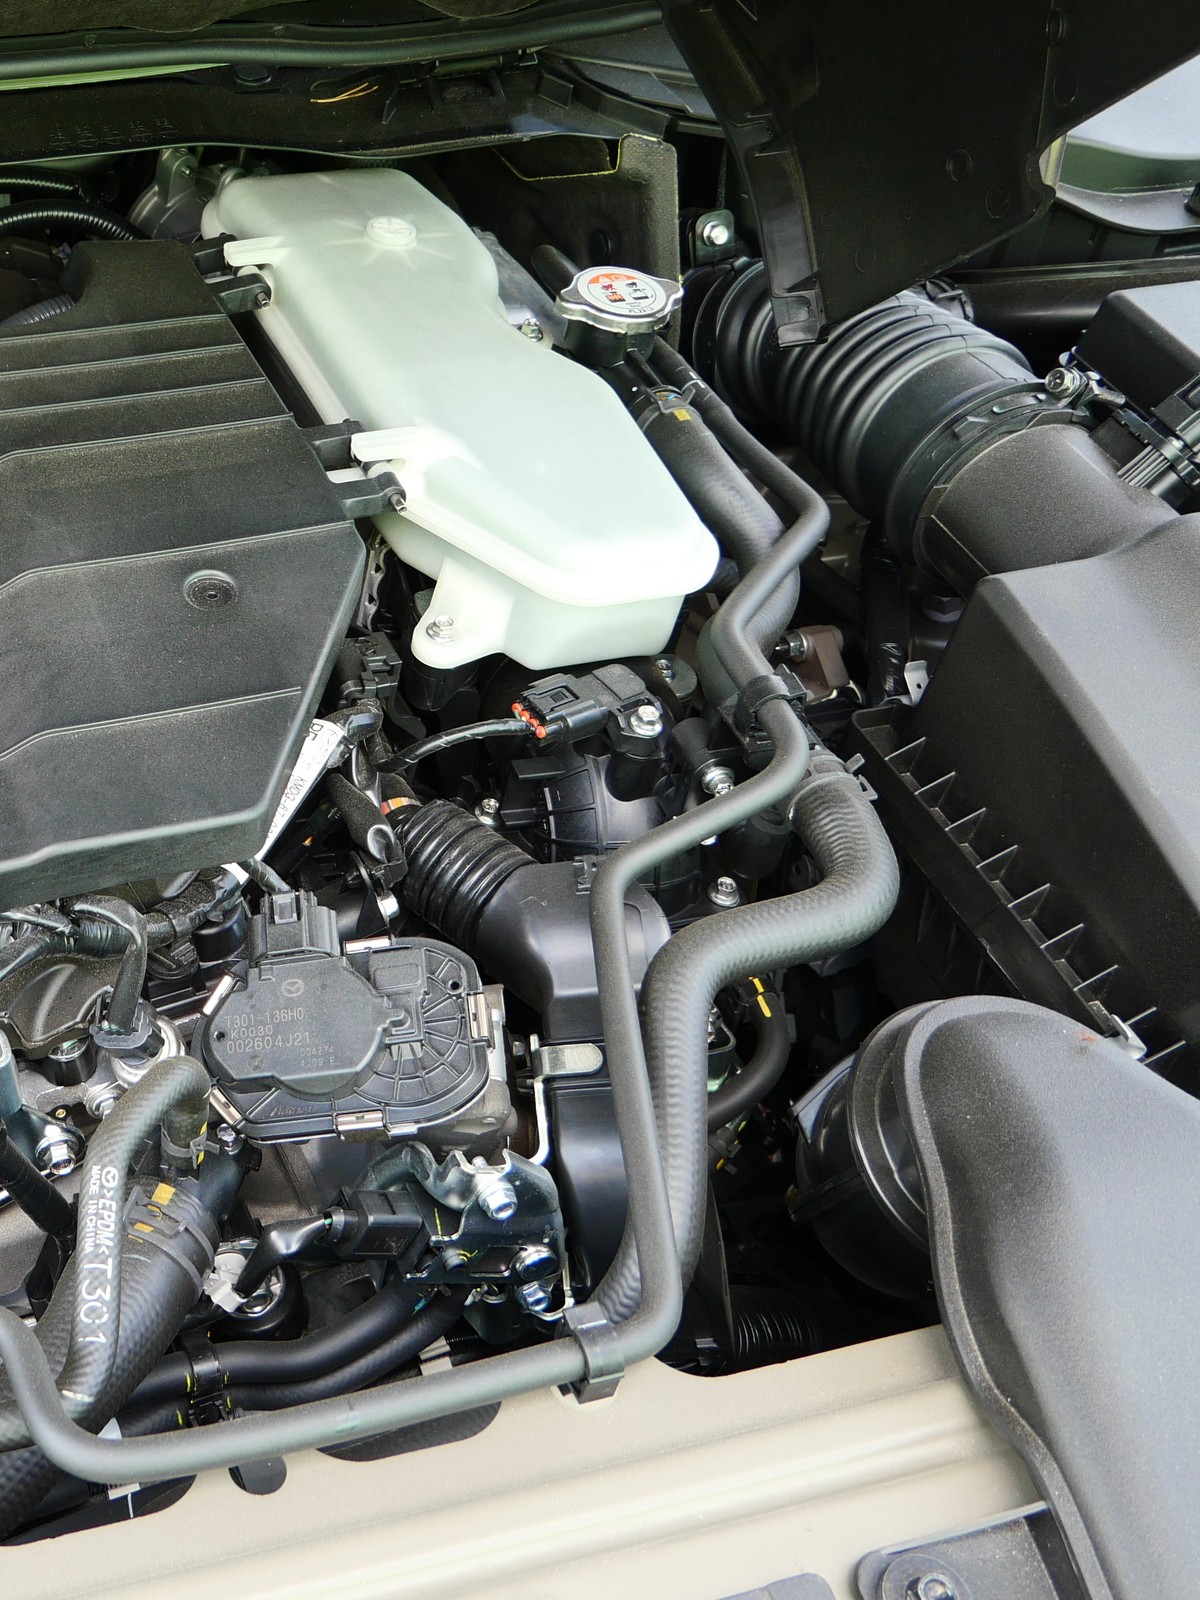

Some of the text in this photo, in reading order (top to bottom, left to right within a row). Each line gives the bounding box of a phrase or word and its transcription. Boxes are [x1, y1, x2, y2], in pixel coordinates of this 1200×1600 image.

[224, 1007, 304, 1028] T301-136H0
[227, 1031, 310, 1053] 002604J21
[231, 1025, 273, 1039] K0030
[84, 1165, 101, 1255] MADE IN CHINA
